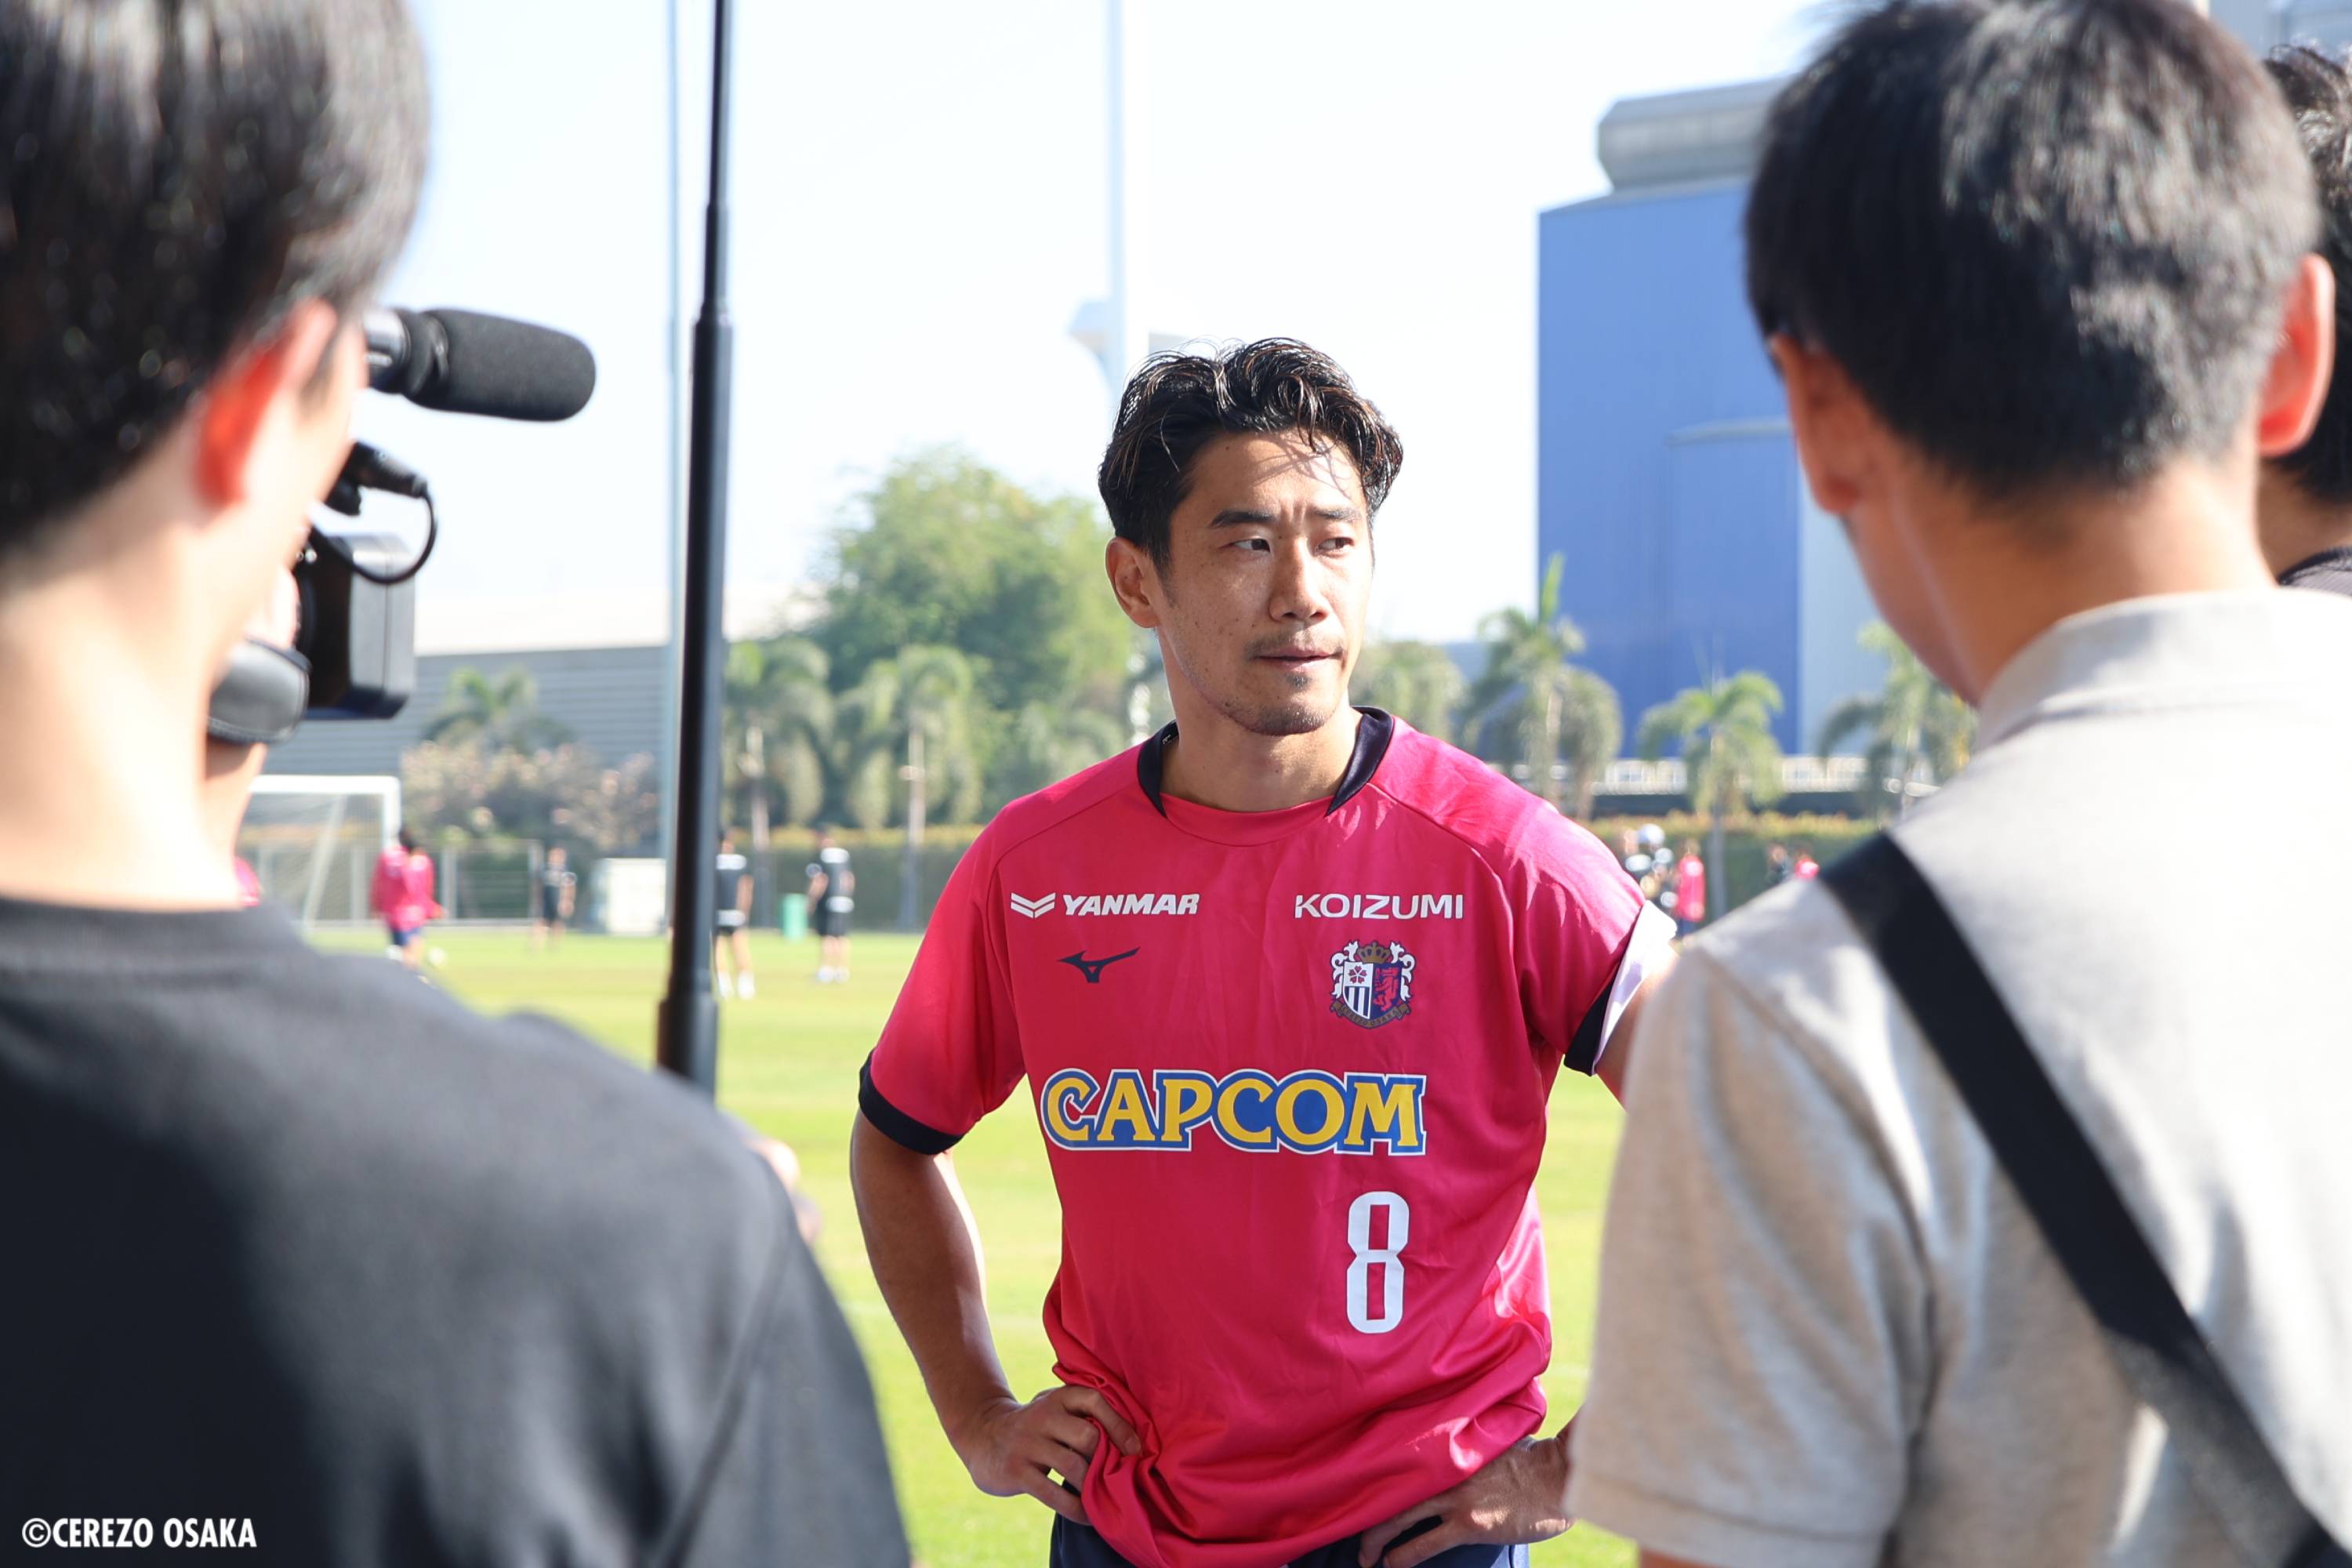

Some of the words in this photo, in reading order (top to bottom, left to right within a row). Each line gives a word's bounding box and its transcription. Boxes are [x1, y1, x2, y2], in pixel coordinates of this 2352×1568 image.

[1062, 893, 1200, 916] YANMAR
[1294, 893, 1464, 920] KOIZUMI
[1040, 1067, 1428, 1156] CAPCOM
[1345, 1190, 1410, 1334] 8
